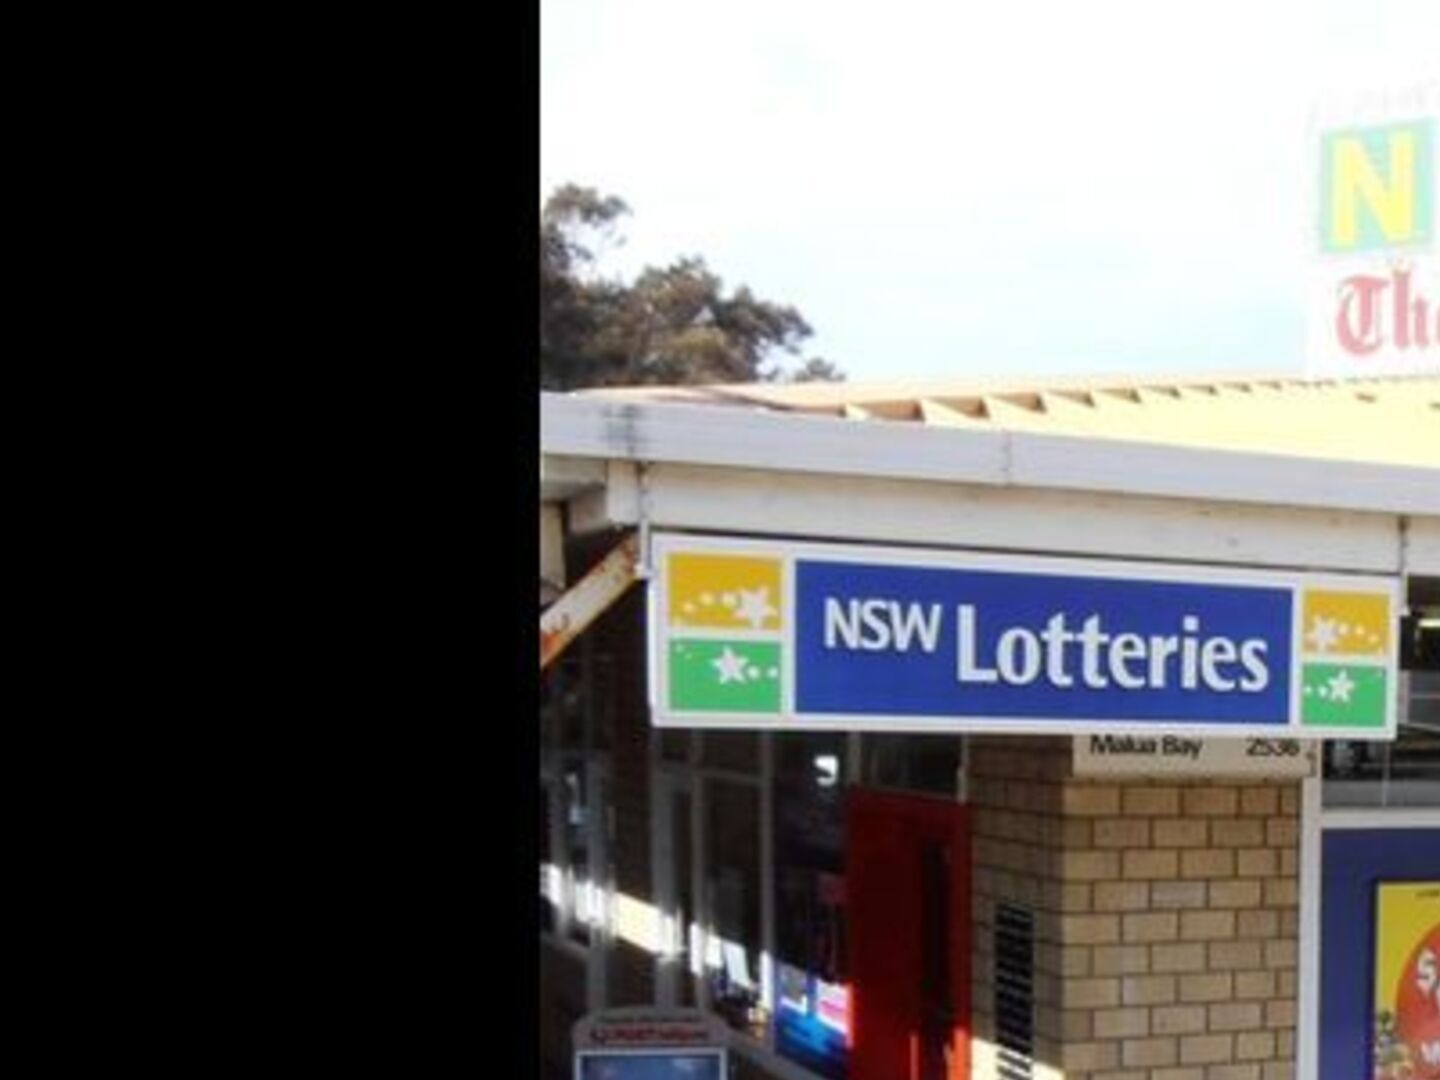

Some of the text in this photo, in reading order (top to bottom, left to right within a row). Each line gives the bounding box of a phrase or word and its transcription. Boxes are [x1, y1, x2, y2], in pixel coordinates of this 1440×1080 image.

[1331, 131, 1418, 247] N
[825, 598, 1268, 692] NSW Lotteries
[1091, 735, 1156, 755] Malua
[1162, 736, 1203, 760] Bay
